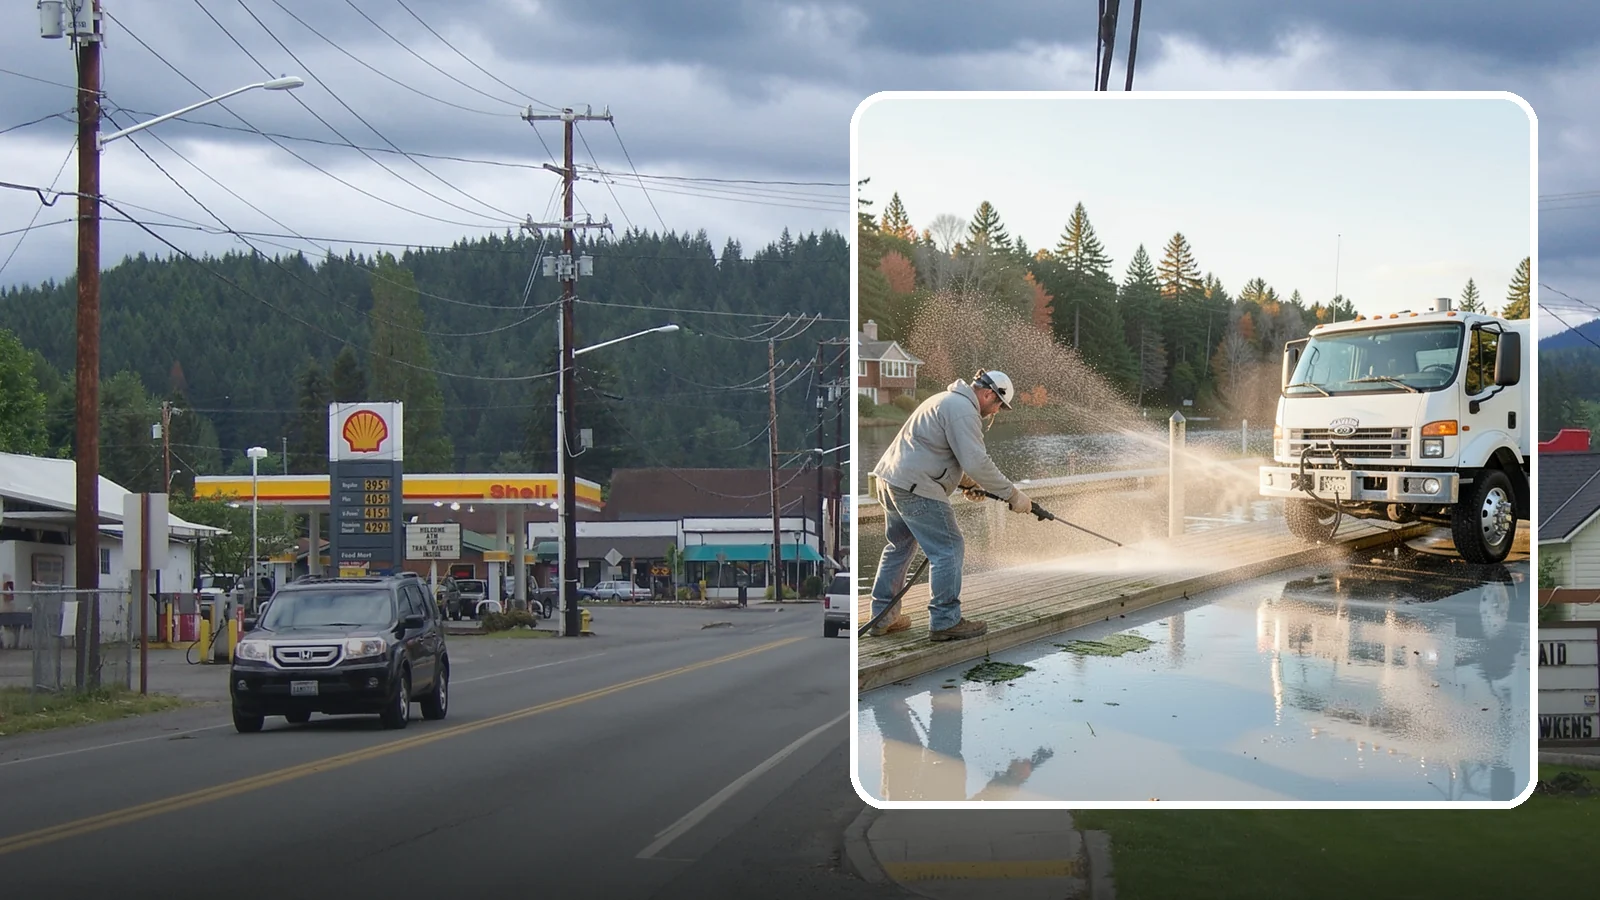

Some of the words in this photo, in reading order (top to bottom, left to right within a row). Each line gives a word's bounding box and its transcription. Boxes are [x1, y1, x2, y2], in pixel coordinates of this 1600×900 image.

[365, 480, 384, 490] 395
[490, 484, 547, 499] Shell
[365, 494, 383, 504] 405
[365, 508, 383, 518] 415
[365, 522, 384, 532] 429
